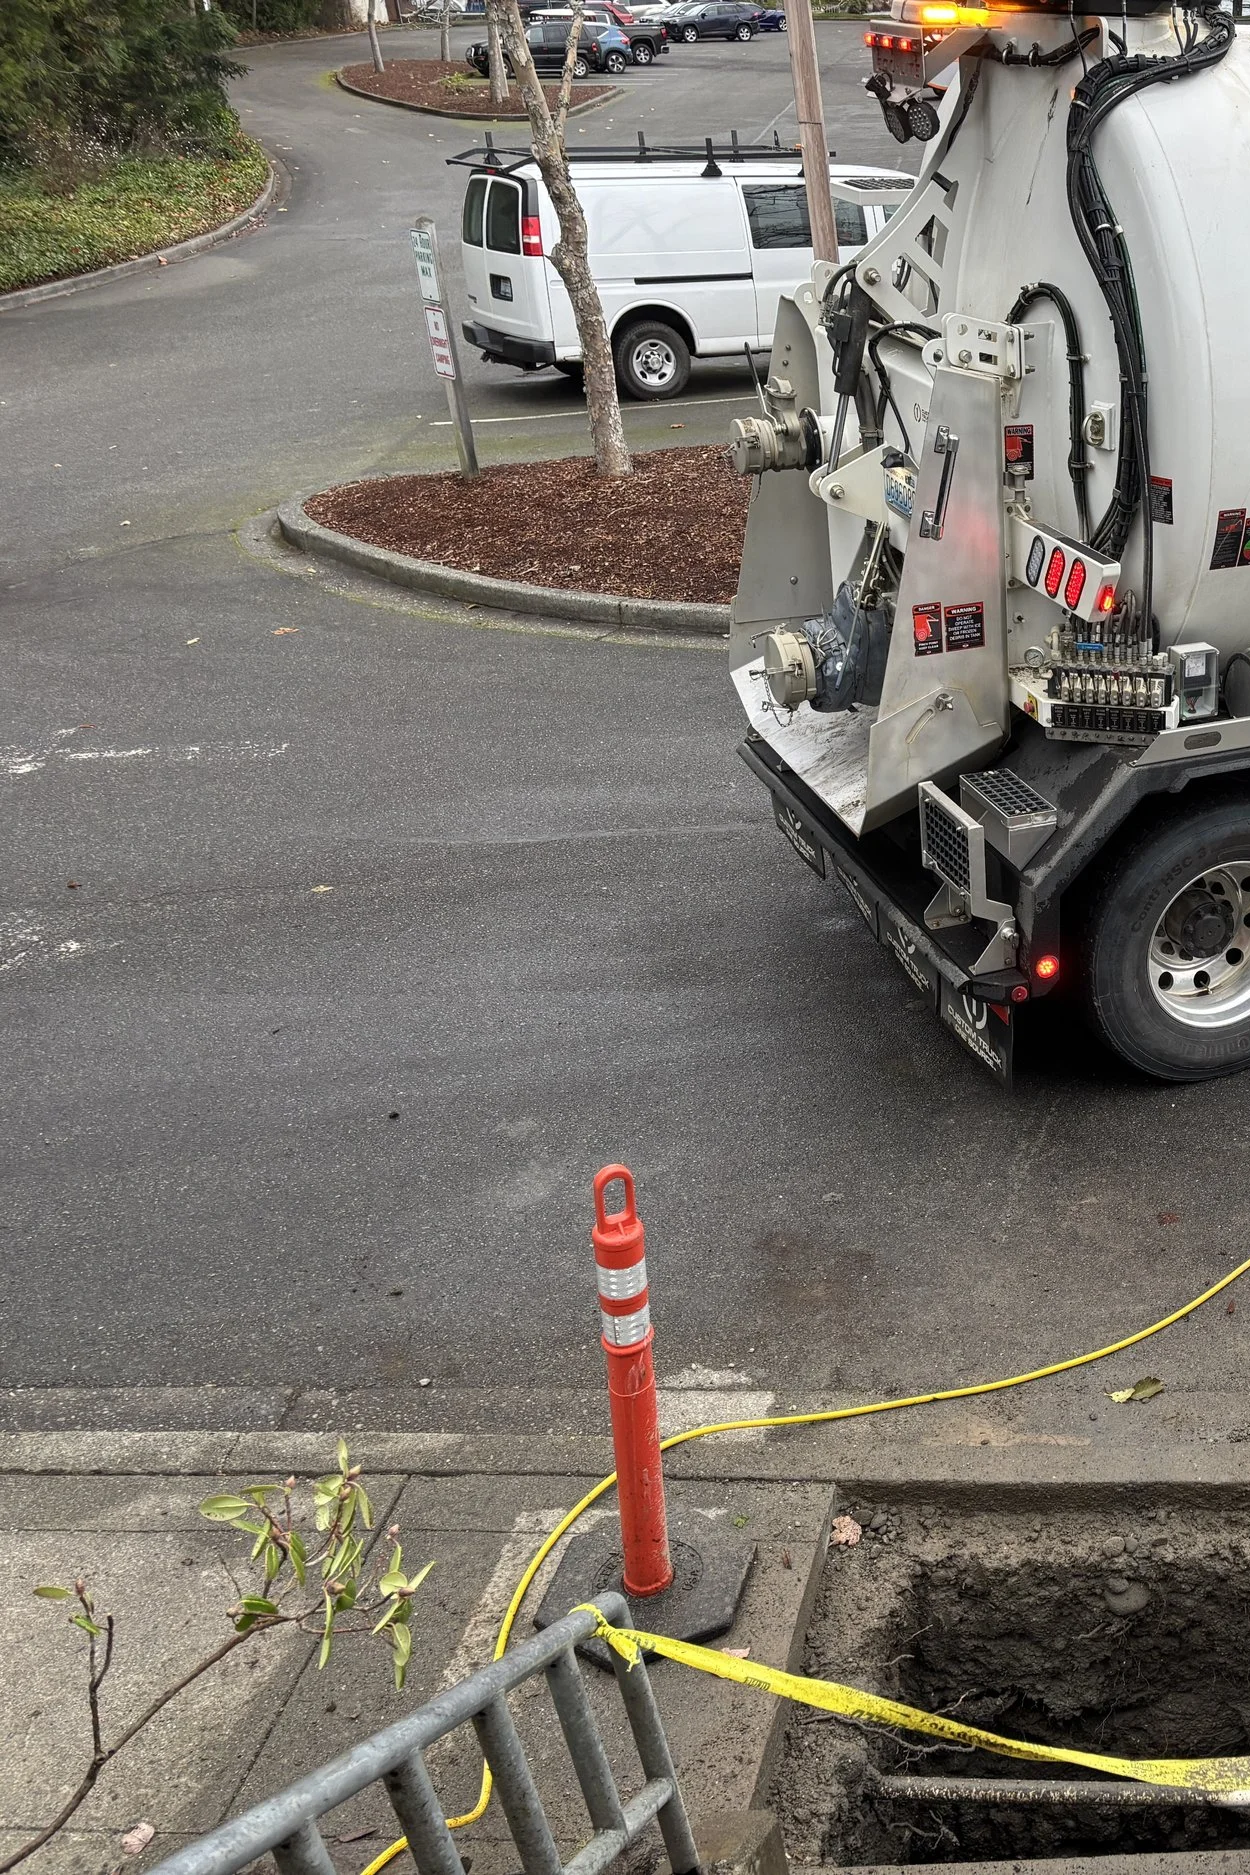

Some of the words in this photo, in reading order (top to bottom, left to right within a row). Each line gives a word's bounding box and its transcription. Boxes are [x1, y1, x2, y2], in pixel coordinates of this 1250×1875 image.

[414, 250, 433, 265] PARKING
[420, 265, 432, 278] MAX
[1007, 427, 1032, 435] WARNING
[951, 606, 977, 614] WARNING
[1161, 856, 1193, 887] HSC
[909, 960, 929, 990] TRUCK
[947, 1004, 977, 1041] CUSTOM
[978, 1035, 1002, 1069] TRUCK
[954, 1023, 968, 1042] ONE
[967, 1038, 997, 1071] SOURCE
